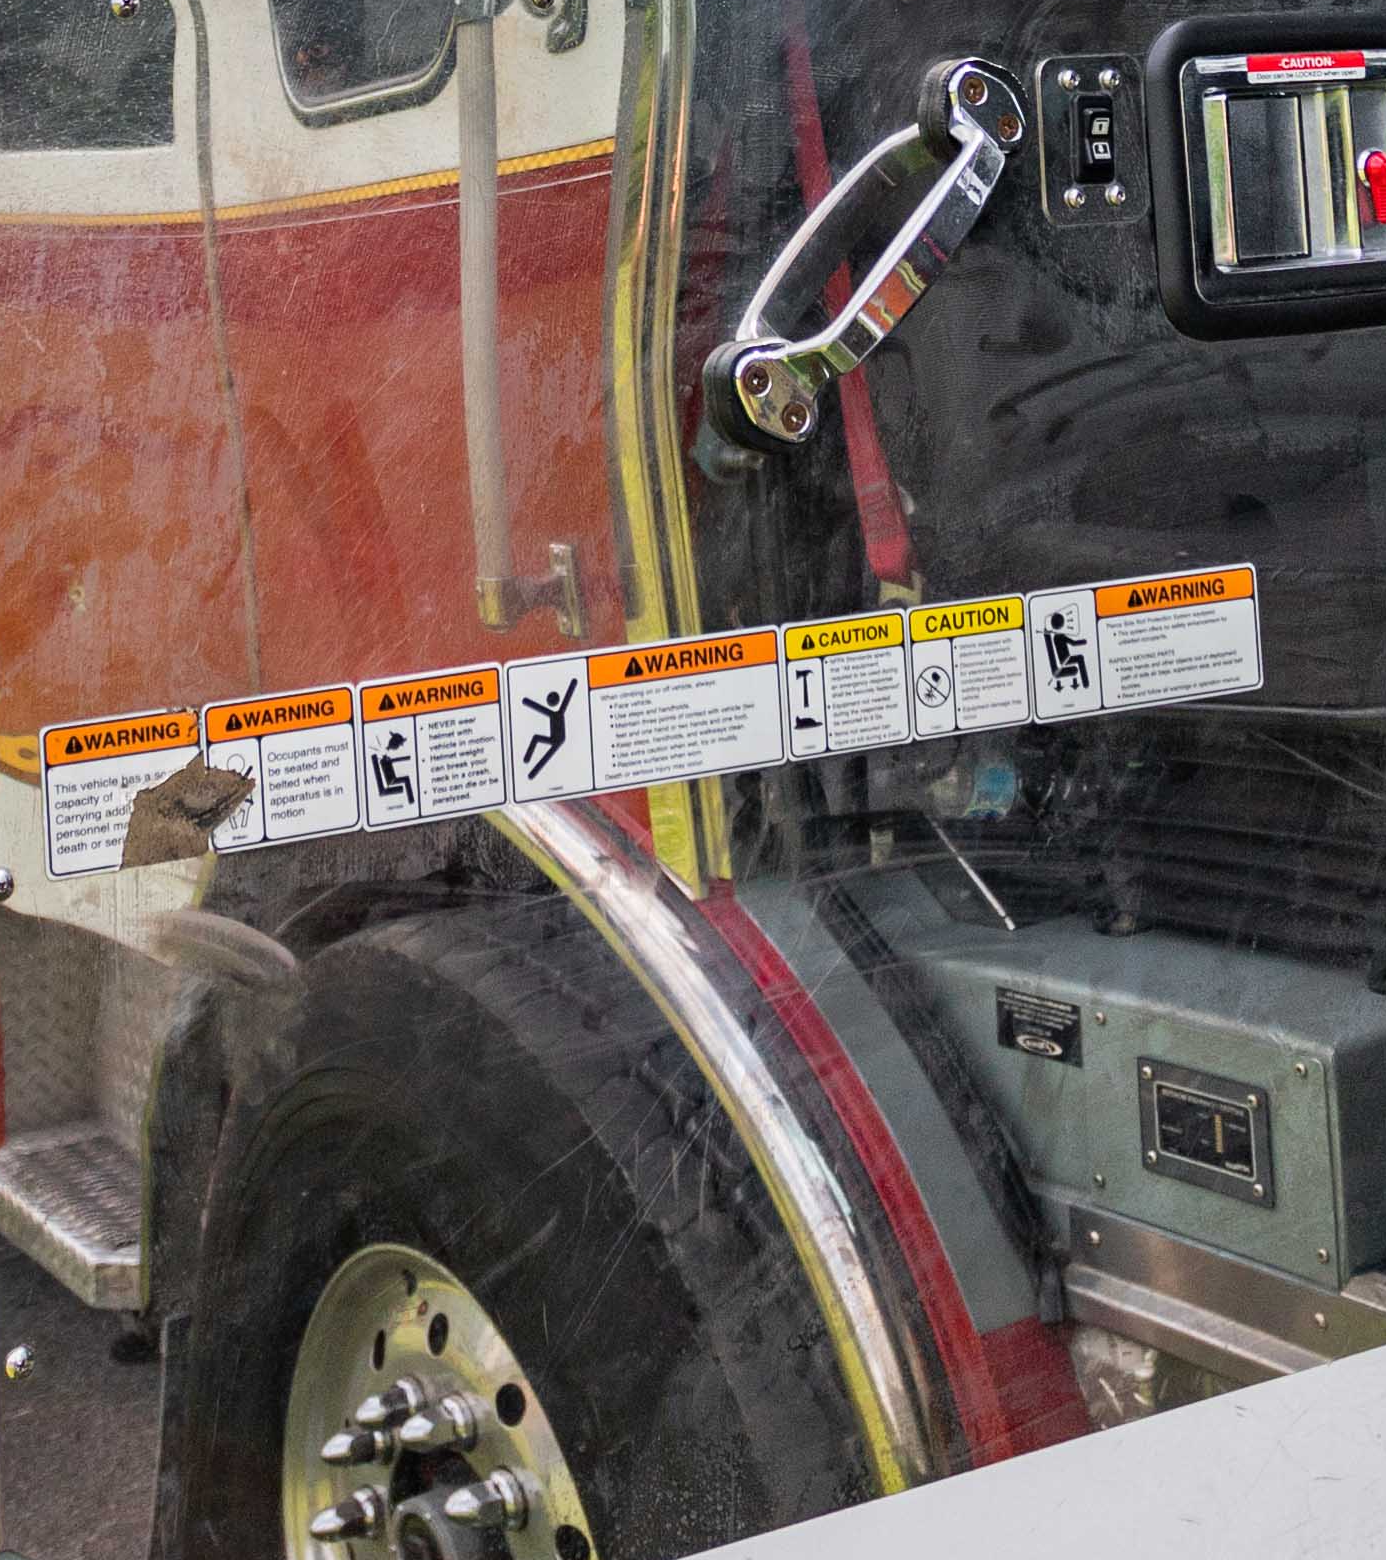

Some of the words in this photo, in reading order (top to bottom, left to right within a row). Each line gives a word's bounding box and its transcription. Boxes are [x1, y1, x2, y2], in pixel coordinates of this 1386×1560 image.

[1295, 70, 1323, 79] LOCKED
[1141, 578, 1225, 604] WARNING
[925, 605, 1009, 633] CAUTION
[818, 623, 888, 647] CAUTION
[644, 642, 744, 673] WARNING
[396, 678, 483, 709] WARNING
[243, 699, 334, 728] WARNING
[428, 718, 455, 730] NEVER
[457, 716, 475, 725] wear
[83, 721, 179, 751] WARNING
[429, 729, 454, 740] helmet
[457, 726, 472, 735] with
[267, 745, 321, 763] Occupants
[324, 741, 348, 753] must
[429, 740, 456, 751] vehicle
[430, 751, 456, 761] Helmet
[458, 746, 484, 759] weight
[268, 766, 280, 776] be
[284, 759, 317, 773] seated
[321, 757, 339, 768] and
[446, 760, 467, 770] break
[470, 758, 487, 768] your
[54, 781, 76, 795] This
[81, 776, 117, 791] vehicle
[121, 773, 141, 785] has
[268, 777, 300, 791] belted
[303, 773, 330, 785] when
[431, 773, 448, 783] neck
[432, 784, 446, 794] You
[449, 783, 462, 791] can
[464, 779, 476, 788] die
[488, 776, 498, 784] be
[54, 794, 99, 811] capacity
[102, 792, 113, 802] of
[270, 789, 319, 806] apparatus
[323, 787, 332, 796] is
[334, 785, 343, 795] in
[55, 808, 101, 826] Carrying
[270, 806, 305, 820] motion
[55, 822, 110, 841] personnel
[56, 840, 87, 855] death
[90, 840, 101, 849] or
